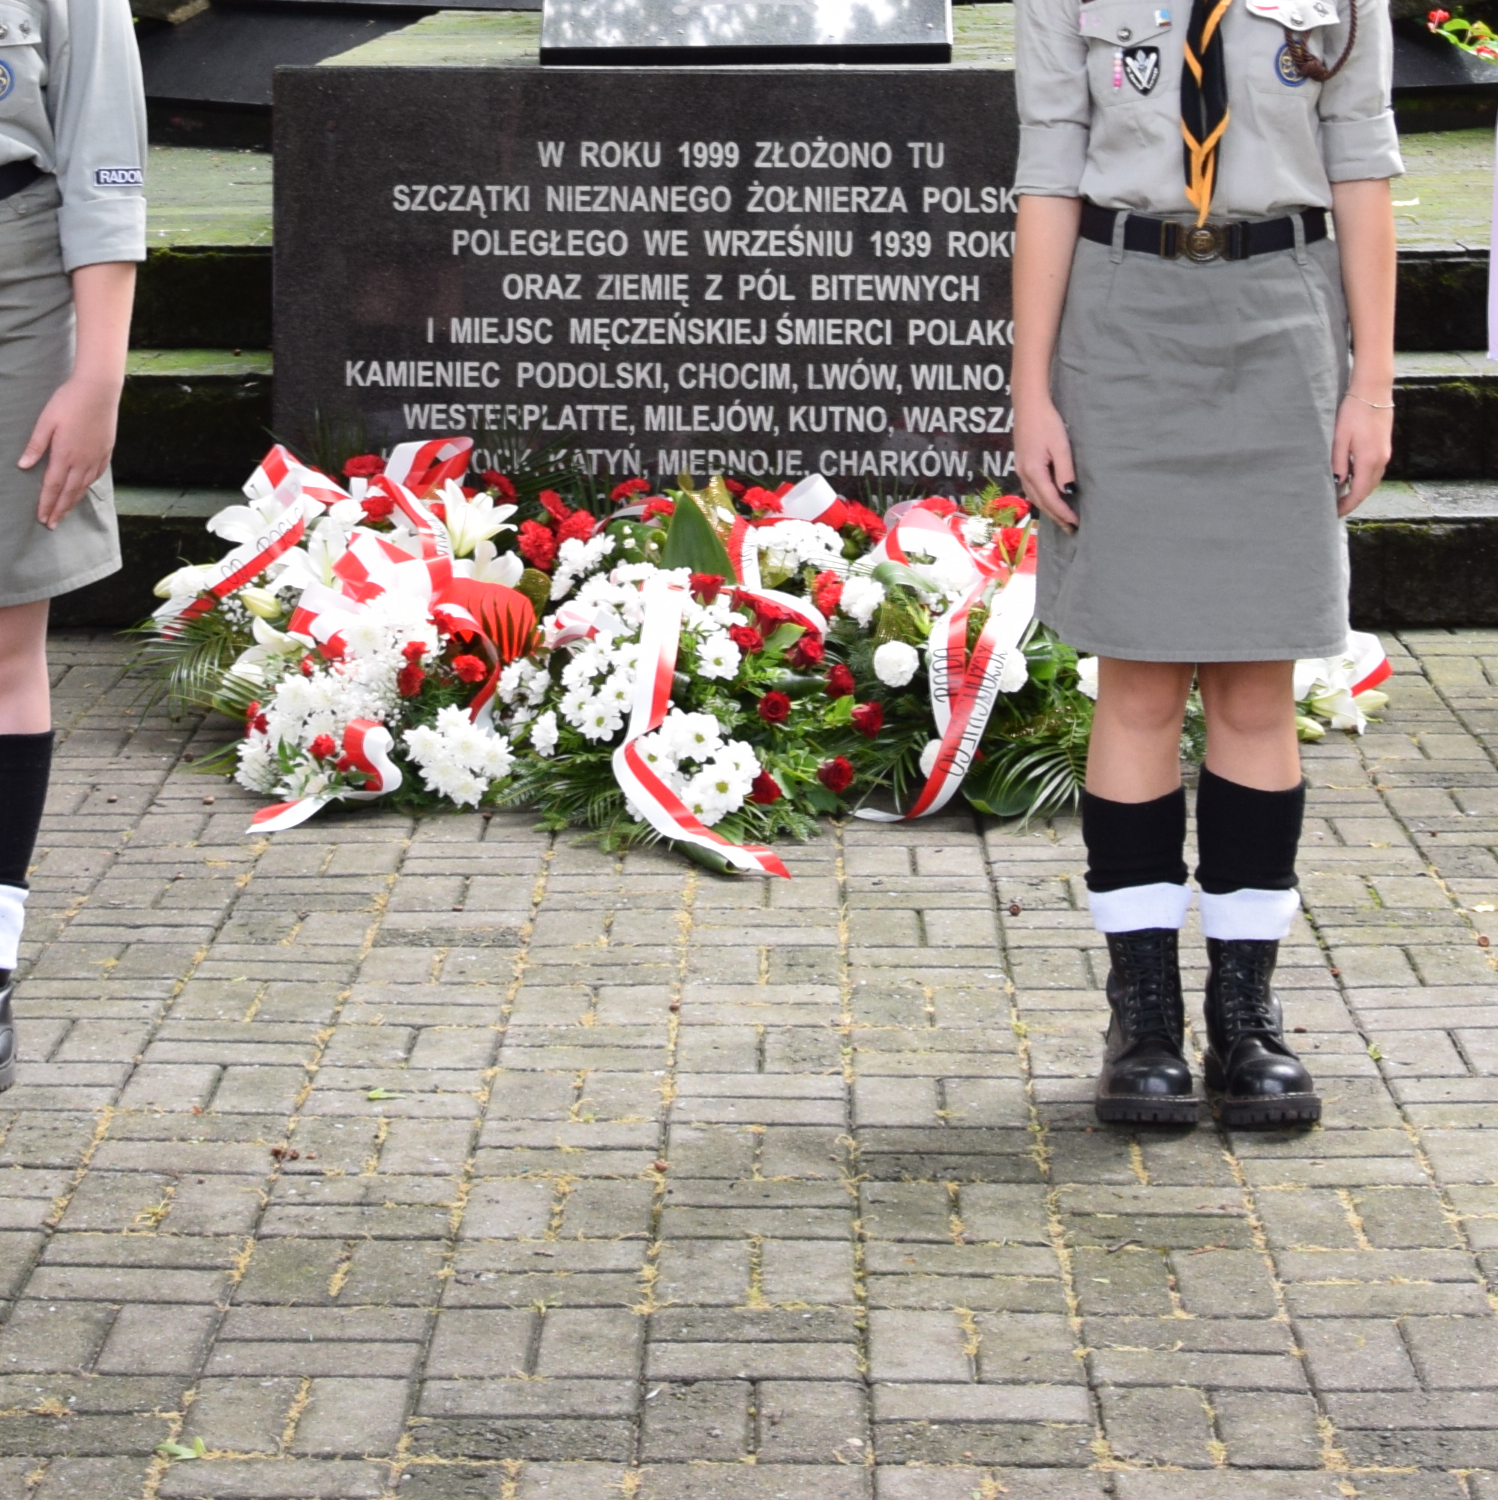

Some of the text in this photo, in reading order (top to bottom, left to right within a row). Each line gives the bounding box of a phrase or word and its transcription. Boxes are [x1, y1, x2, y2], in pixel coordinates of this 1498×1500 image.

[538, 136, 944, 168] W ROKU 1999 ZŁOŻONO TU
[393, 180, 1017, 218] SZCZĄTKI NIEZNANEGO ŻOŁNIERZA POLSK
[453, 224, 1013, 258] POLEGŁEGO WE WRZEŚNIU 1939 ROK
[502, 268, 979, 307] ORAZ ZIEMIĘ Z PÓL BITEWNYCH
[427, 317, 434, 344] I
[451, 317, 553, 344] MIEJSC
[570, 312, 767, 351] MĘCZEŃSKIEJ
[776, 312, 892, 345] ŚMIERCI
[346, 358, 1009, 395] KAMIENIEC PODOLSKI, CHOCIM, LWÓW, WILNO,
[403, 404, 635, 436] WESTERPLATTE,
[645, 399, 779, 436] MILEJÓW,
[789, 406, 894, 437] KUTNO,
[549, 442, 649, 479] KATYŃ,
[658, 448, 810, 479] MIEDNOJE,
[818, 444, 973, 481] CHARKÓW,
